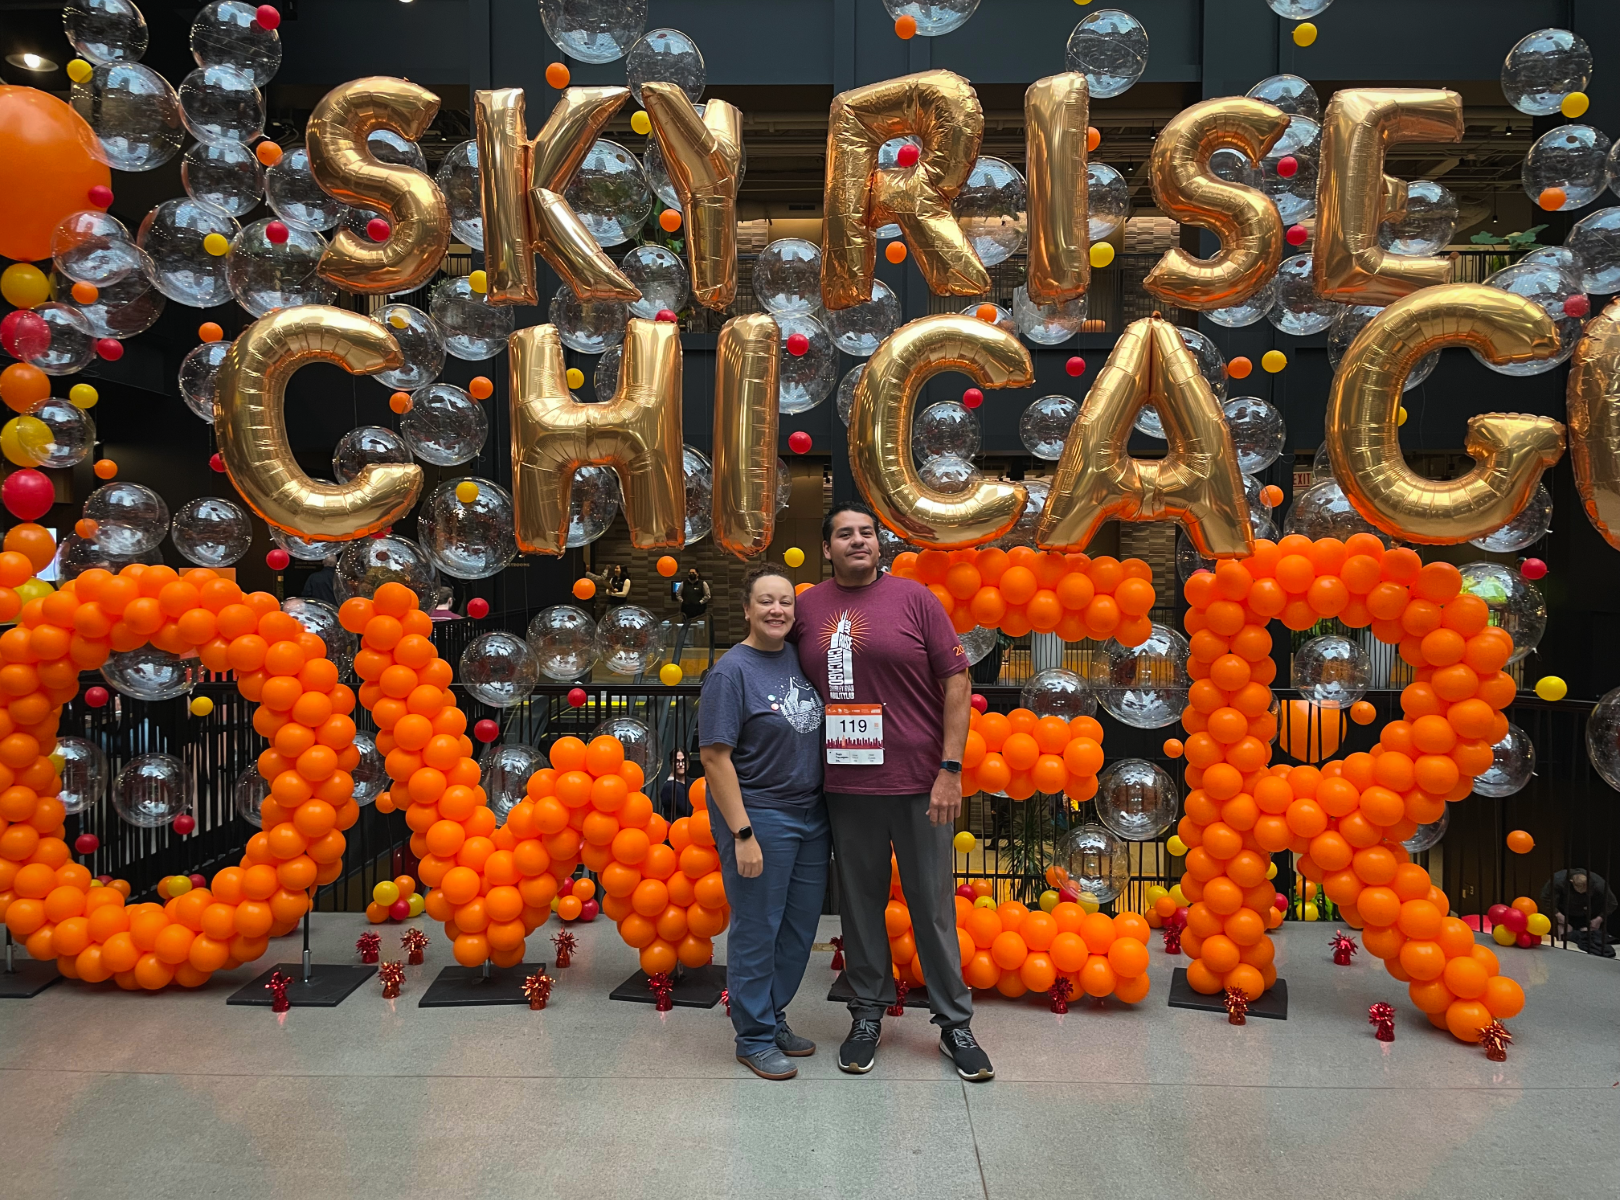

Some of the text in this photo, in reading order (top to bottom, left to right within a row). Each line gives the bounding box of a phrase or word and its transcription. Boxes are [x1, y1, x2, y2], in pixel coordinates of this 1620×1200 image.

[213, 281, 1620, 560] CHICAG
[1293, 473, 1311, 485] EXIT
[844, 619, 852, 636] SKY
[839, 632, 853, 651] RISE
[827, 648, 844, 686] CHICAGO
[839, 719, 867, 733] 119
